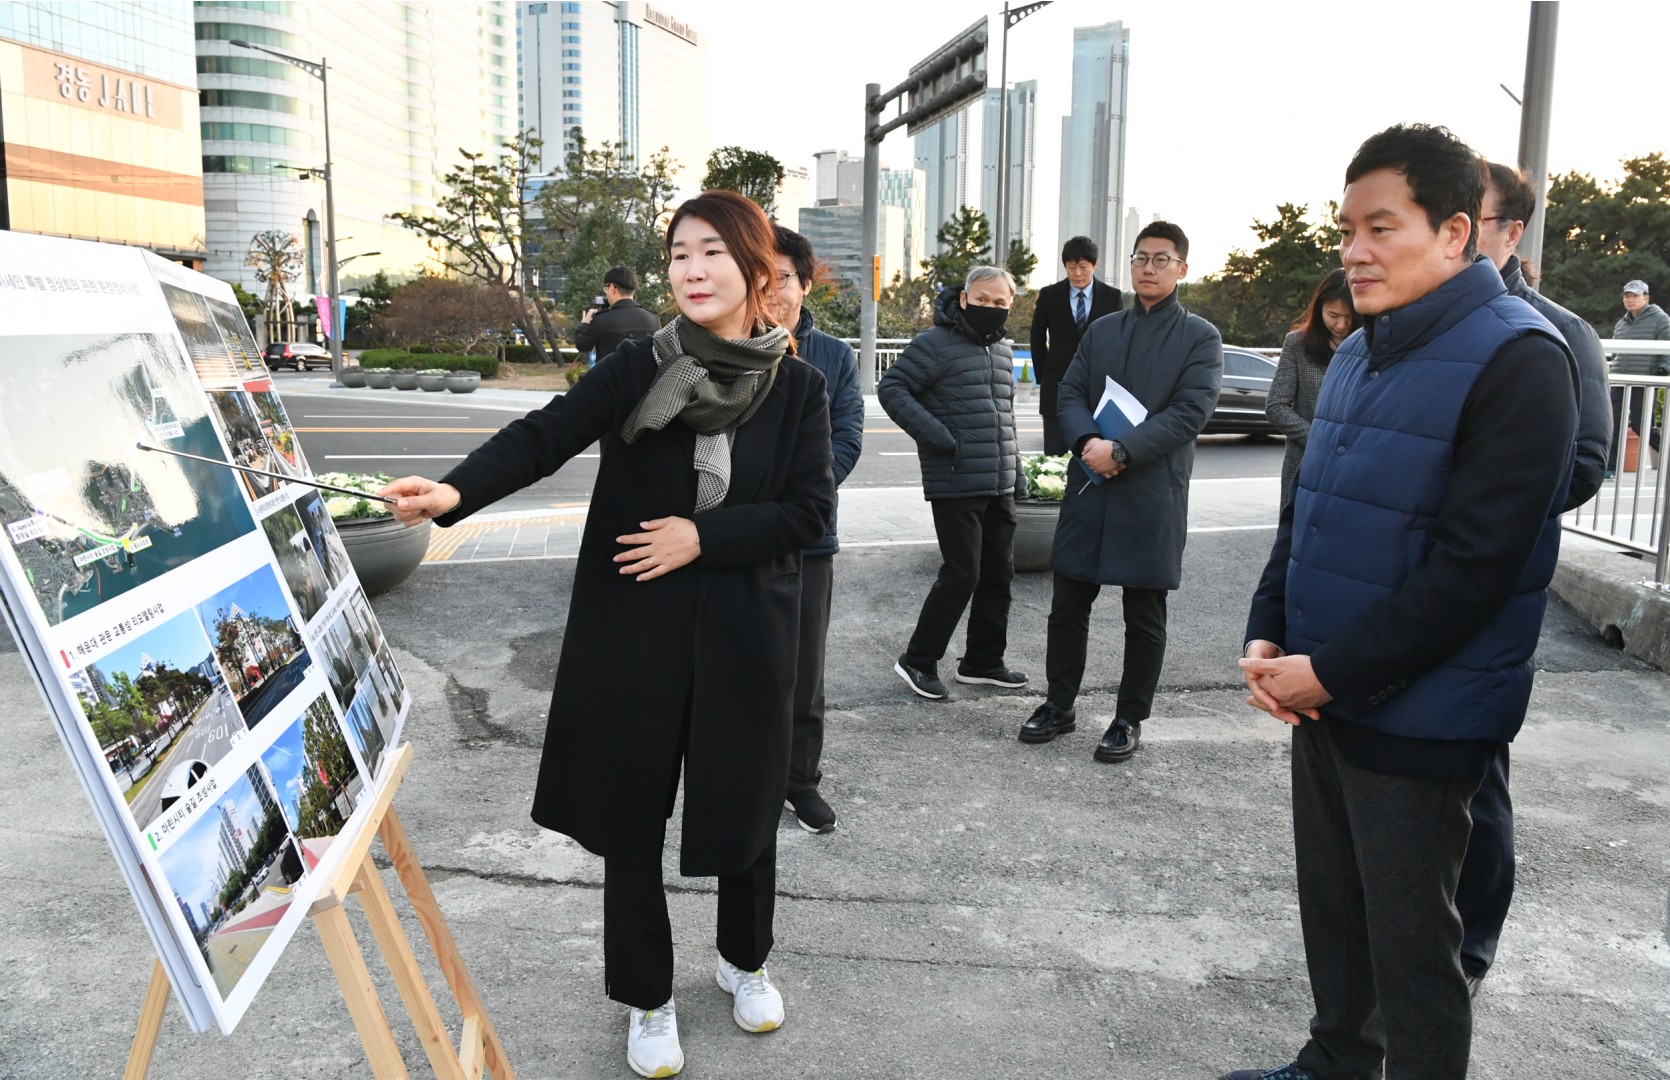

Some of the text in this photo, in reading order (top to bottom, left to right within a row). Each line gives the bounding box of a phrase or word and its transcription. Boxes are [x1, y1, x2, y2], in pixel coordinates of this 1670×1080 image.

[54, 62, 92, 103] 경동
[77, 637, 99, 655] 해운대
[98, 630, 113, 645] 관문
[113, 620, 132, 637] 교통섬
[131, 602, 165, 626] 리모델링사업
[161, 808, 186, 833] 마린시티
[185, 796, 197, 814] 숲길
[197, 778, 217, 802] 조성사업
